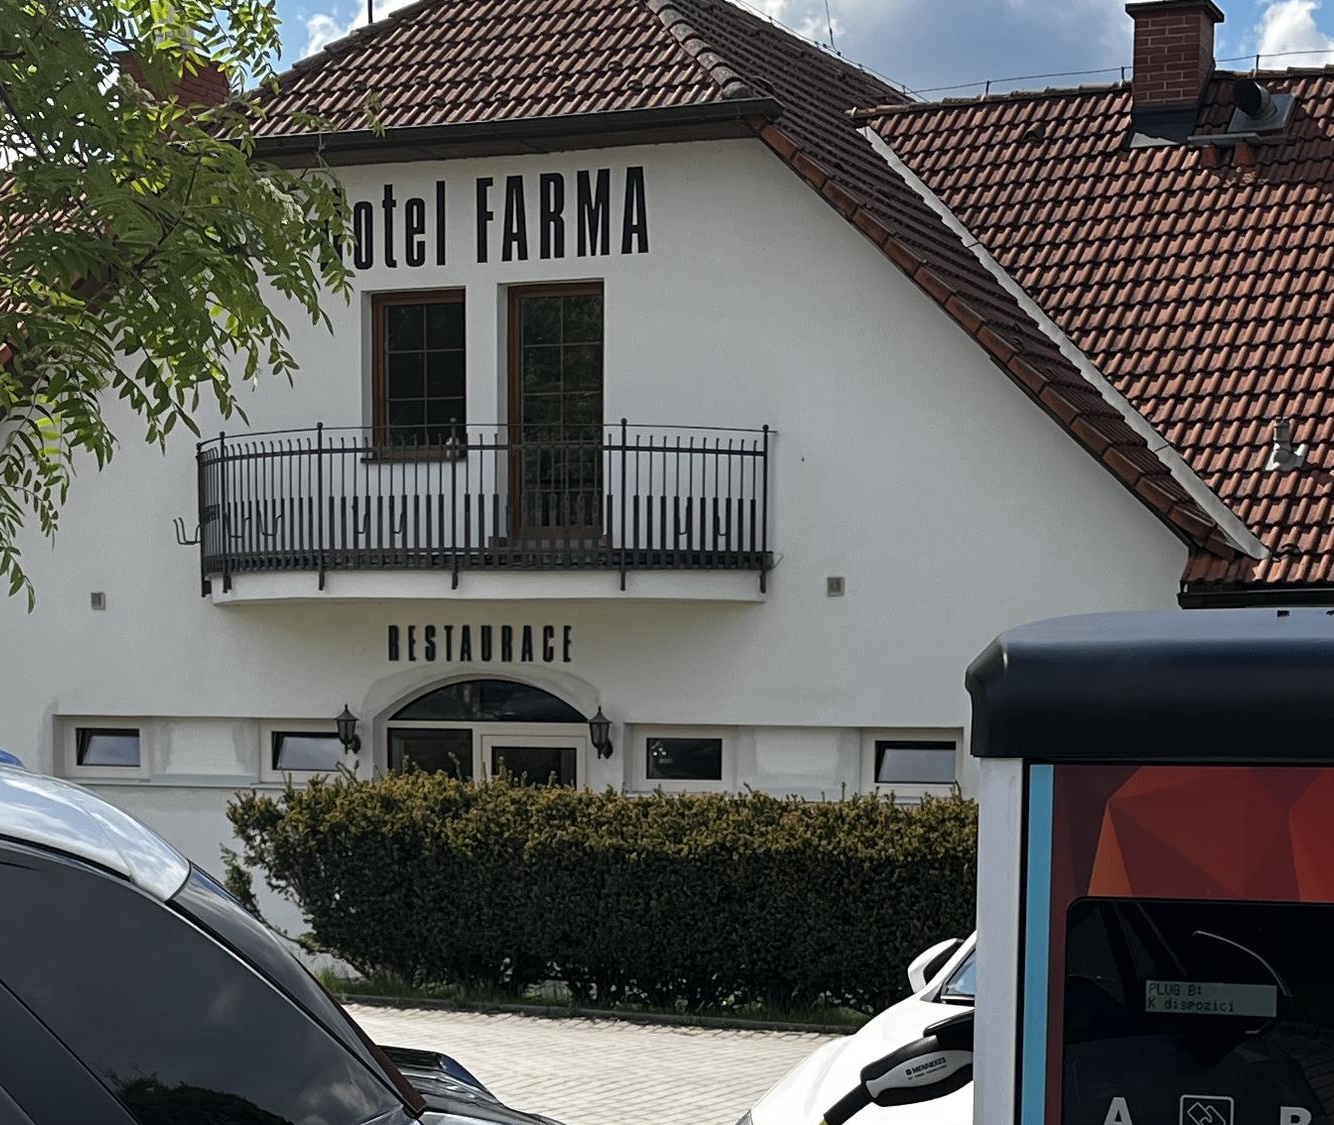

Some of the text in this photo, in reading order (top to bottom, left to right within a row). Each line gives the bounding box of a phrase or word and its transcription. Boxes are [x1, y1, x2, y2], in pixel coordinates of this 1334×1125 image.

[476, 166, 649, 264] FARMA
[387, 624, 573, 663] RESTAURACE
[1148, 982, 1181, 996] PLUG
[1147, 997, 1156, 1009] K
